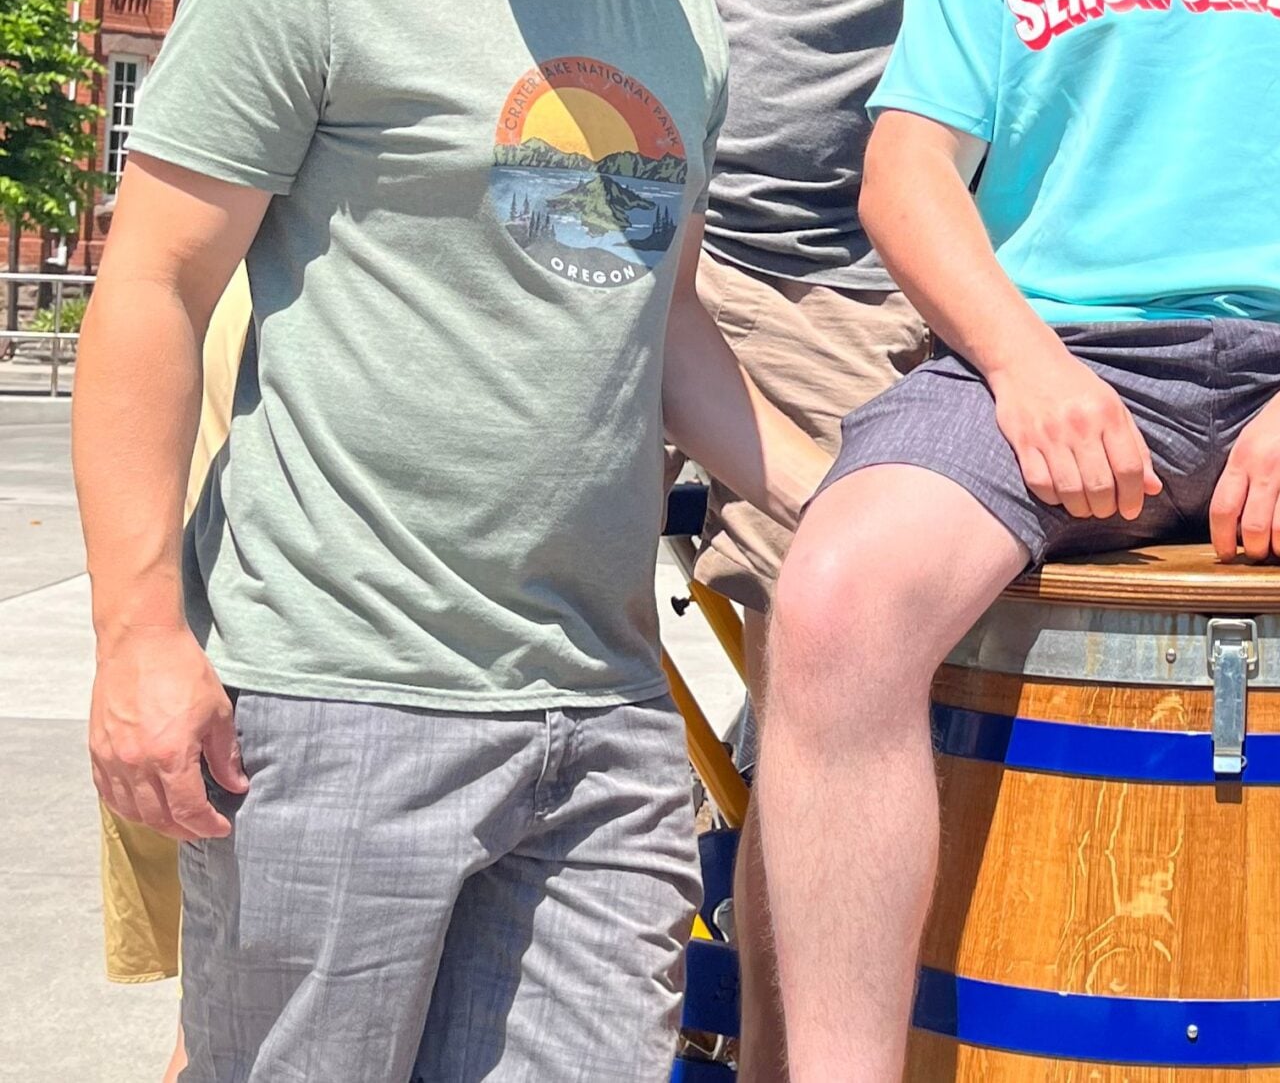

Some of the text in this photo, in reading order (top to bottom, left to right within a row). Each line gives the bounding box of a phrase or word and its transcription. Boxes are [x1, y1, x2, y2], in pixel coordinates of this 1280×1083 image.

[504, 61, 680, 147] CRATER LAKE NATIONAL PARK
[551, 257, 636, 284] OREGON
